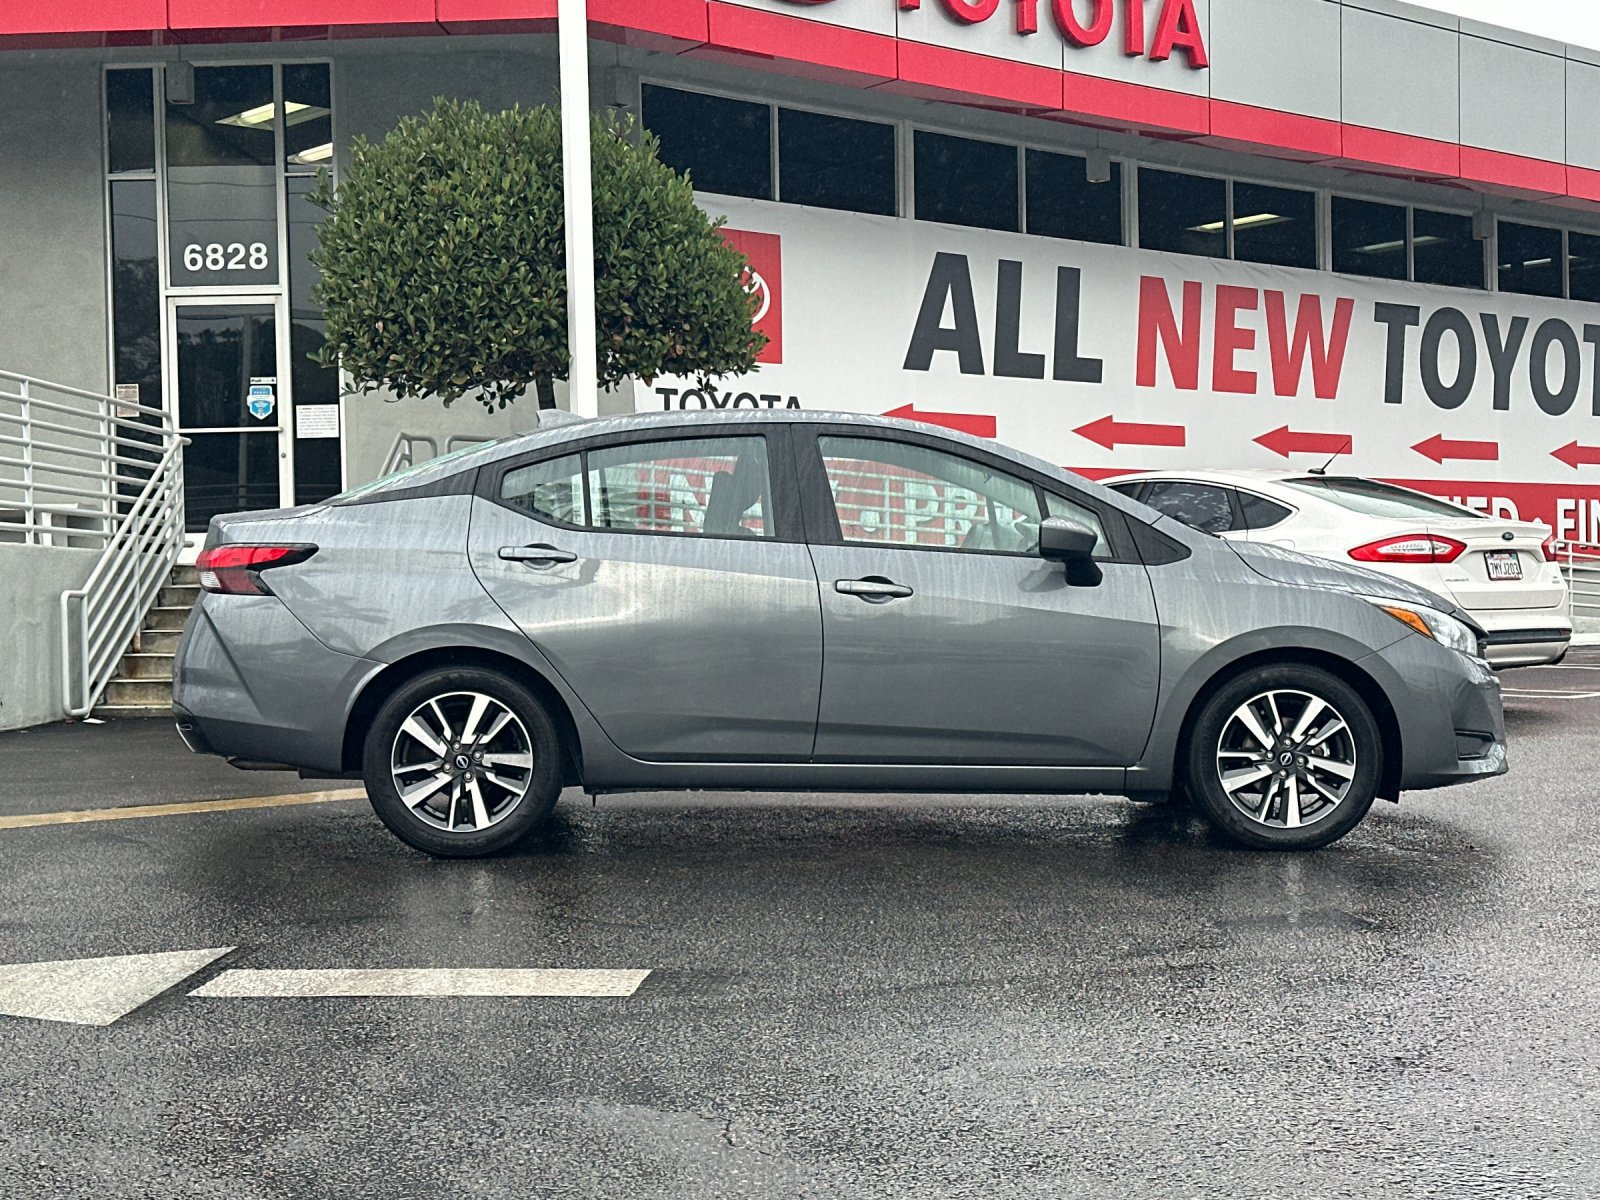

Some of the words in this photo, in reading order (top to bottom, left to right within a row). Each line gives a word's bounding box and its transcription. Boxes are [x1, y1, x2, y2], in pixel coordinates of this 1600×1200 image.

[183, 243, 269, 271] 6828
[903, 252, 1103, 383] ALL
[1136, 275, 1355, 399] NEW
